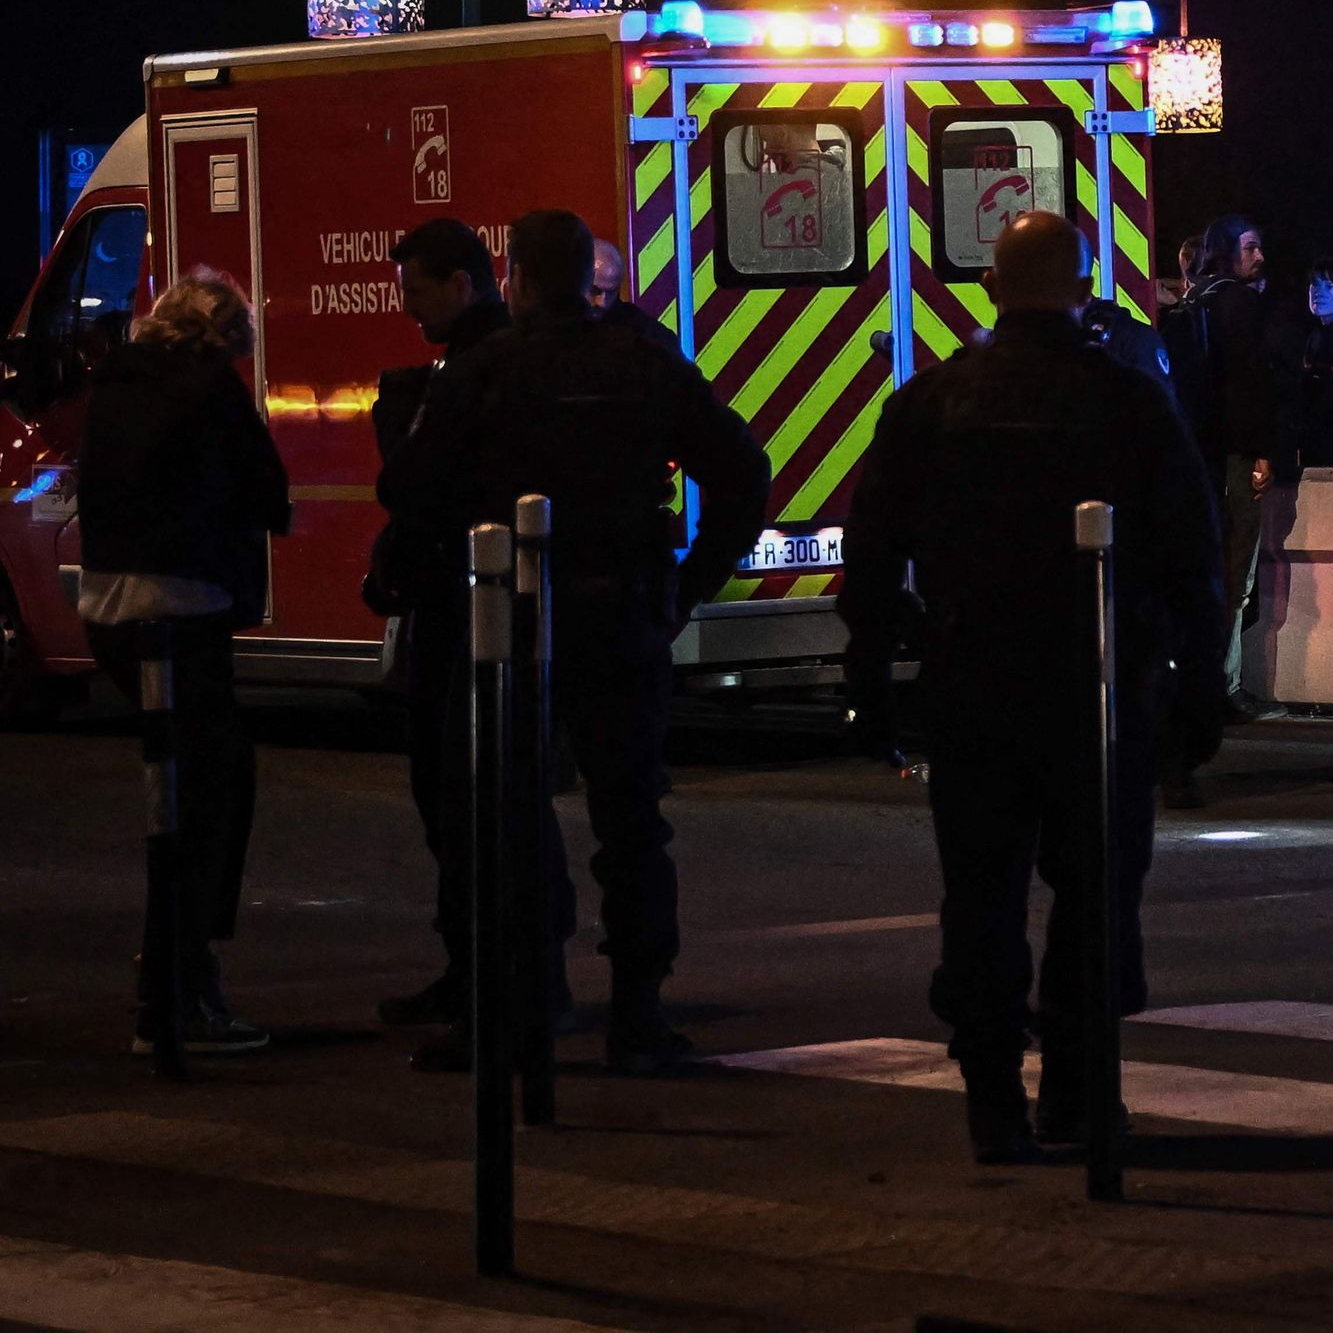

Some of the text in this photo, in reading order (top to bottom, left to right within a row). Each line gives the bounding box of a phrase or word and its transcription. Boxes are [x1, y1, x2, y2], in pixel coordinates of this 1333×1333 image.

[414, 112, 435, 133] 112
[428, 169, 448, 199] 18
[784, 214, 816, 243] 18
[311, 281, 404, 315] D'ASSISTA
[752, 539, 844, 566] FR-300-M
